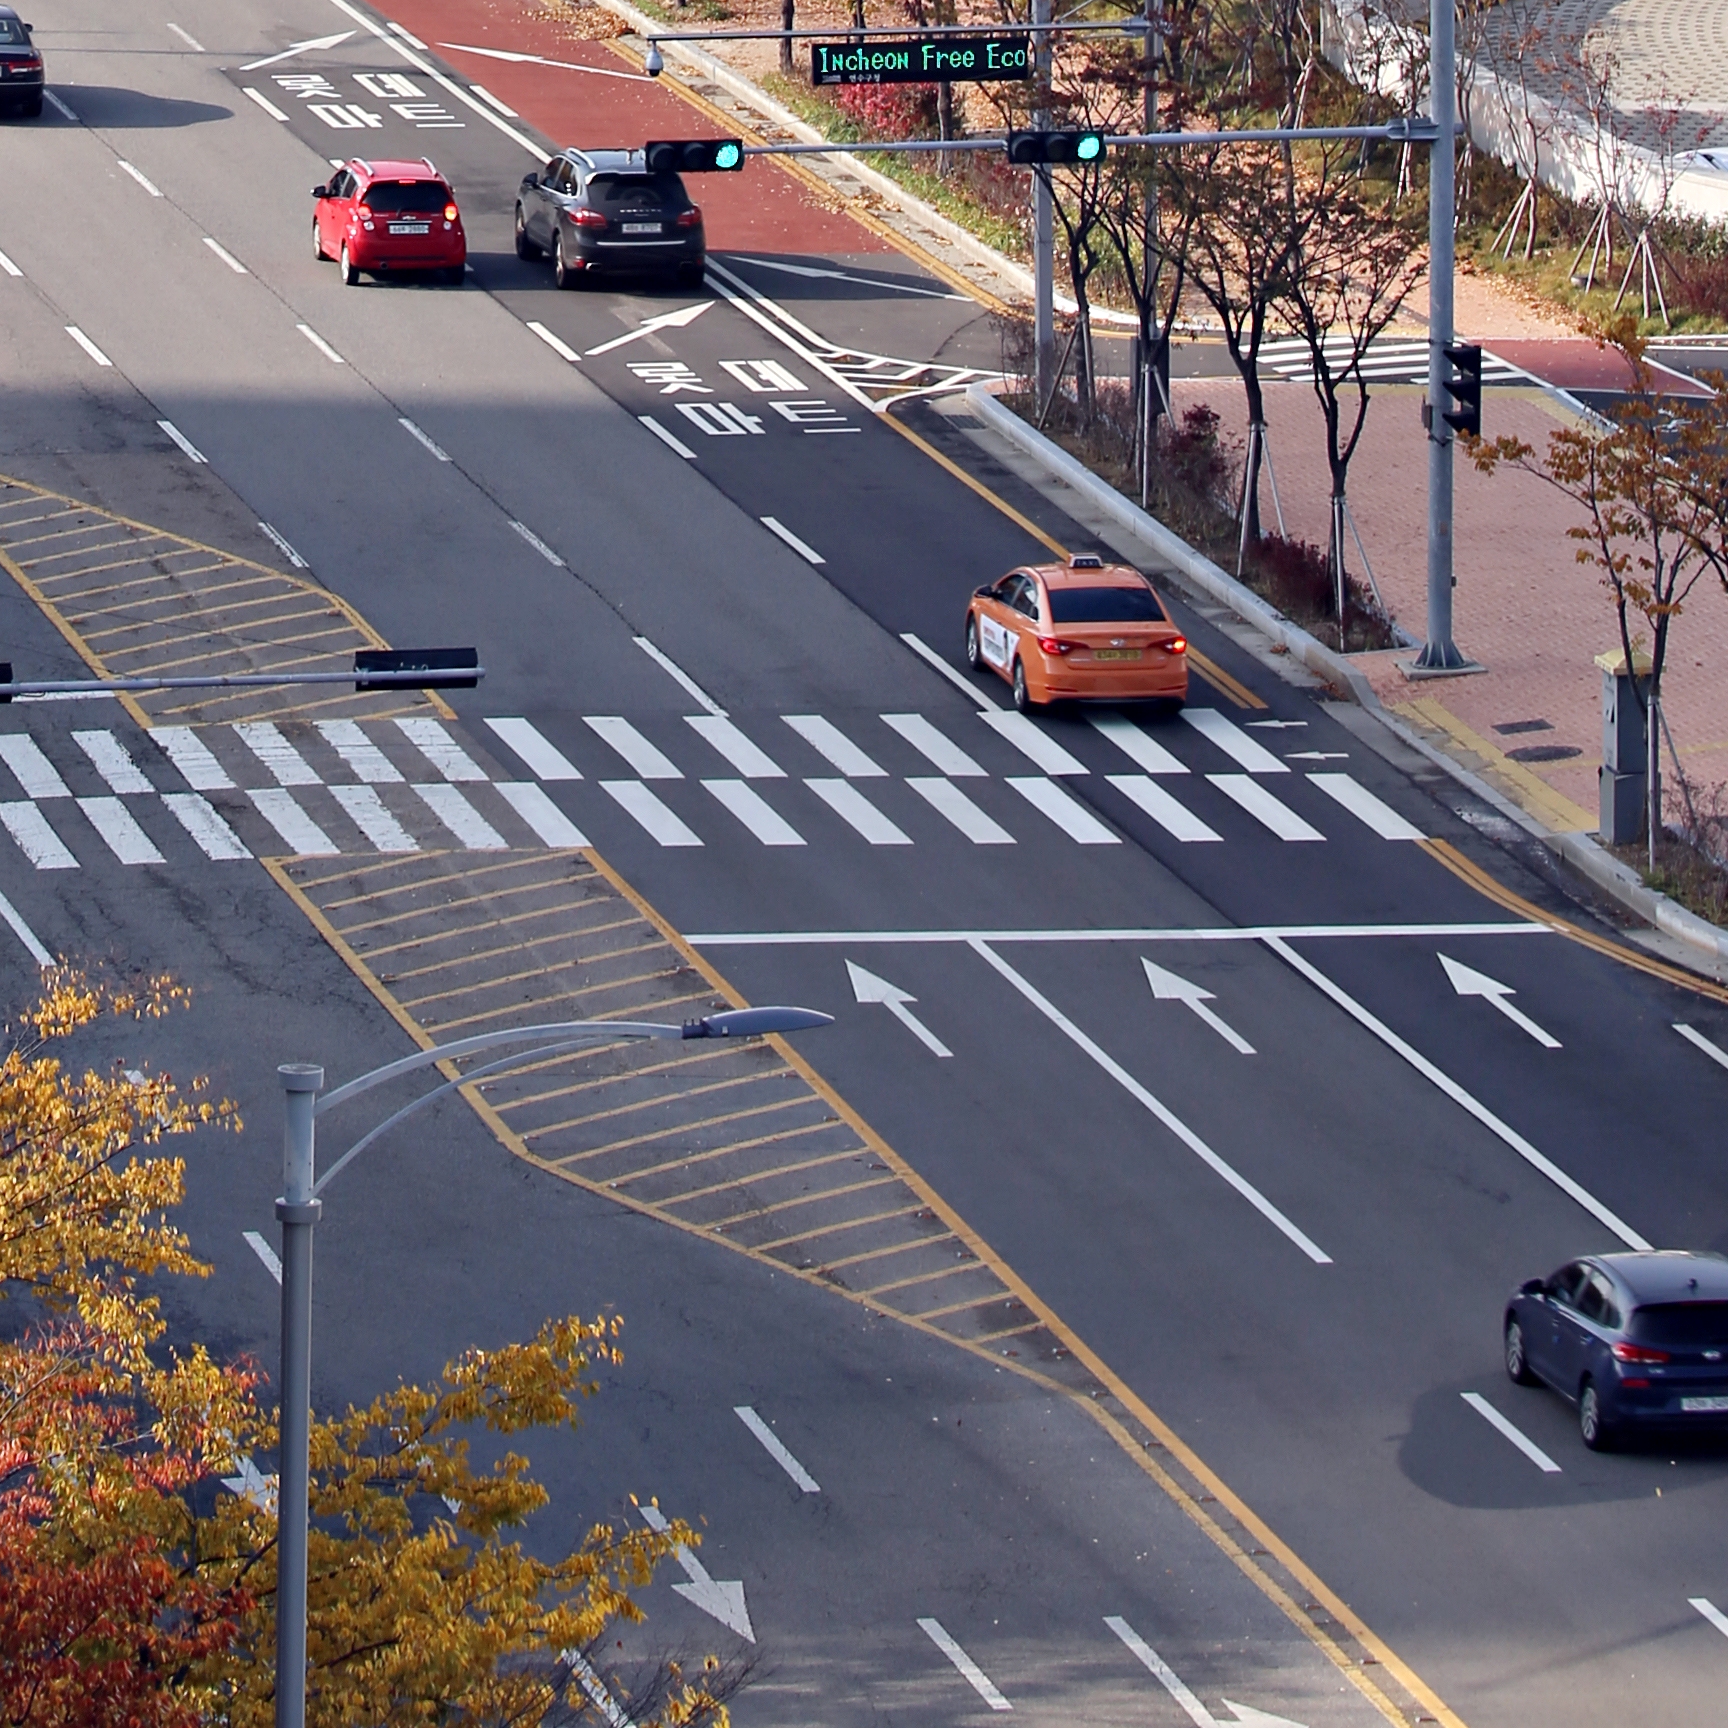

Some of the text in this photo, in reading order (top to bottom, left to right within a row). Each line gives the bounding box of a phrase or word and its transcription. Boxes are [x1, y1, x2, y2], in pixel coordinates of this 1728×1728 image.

[922, 44, 975, 71] Free
[986, 42, 1026, 69] Eco
[271, 72, 427, 98] 롯데
[306, 103, 466, 129] 마트
[625, 359, 810, 394] 롯데
[673, 399, 862, 436] 마트
